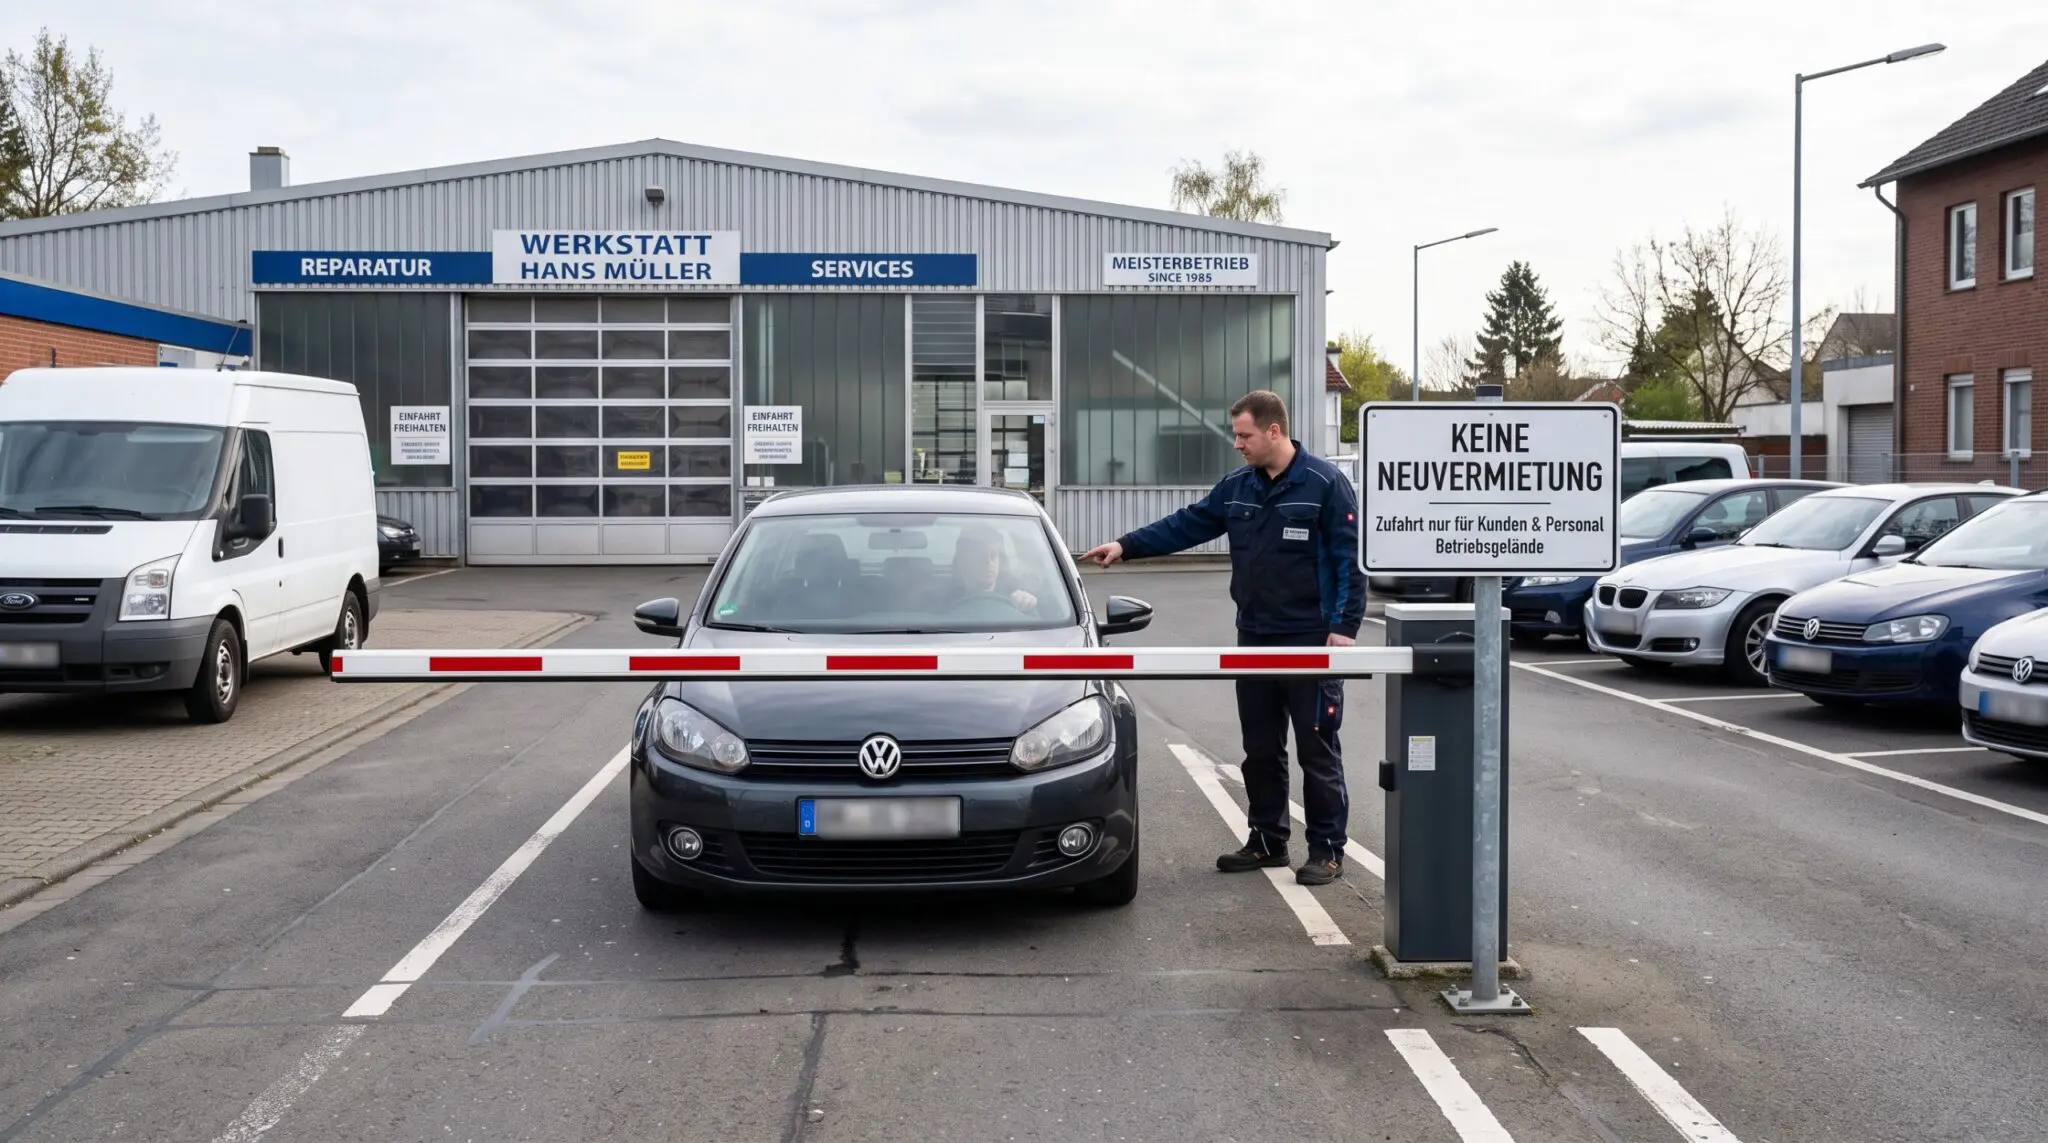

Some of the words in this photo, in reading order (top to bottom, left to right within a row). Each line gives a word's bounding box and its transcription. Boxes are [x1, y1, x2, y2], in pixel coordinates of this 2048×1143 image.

[520, 234, 712, 255] WERKSTATT
[300, 258, 432, 277] REPARATUR
[521, 262, 596, 280] HANS
[604, 258, 712, 280] MÜLLER
[811, 260, 914, 278] SERVICES
[1112, 257, 1249, 270] MEISTERBETRIEB
[1148, 273, 1182, 282] SINCE
[1186, 273, 1212, 282] 1985
[399, 412, 441, 421] EINFAHRT
[752, 412, 794, 421] EINFAHRT
[394, 424, 446, 432] FREIHALTEN
[747, 424, 799, 432] FREIHALTEN
[1451, 423, 1529, 453] KEINE
[1377, 462, 1603, 491] NEUVERMIETUNG
[1375, 516, 1424, 532] Zufahrt
[1428, 519, 1450, 532] nur
[1454, 516, 1474, 532] für
[1478, 516, 1528, 532] Kunden
[1531, 516, 1541, 532] &
[1546, 516, 1604, 532] Personal
[1436, 538, 1544, 558] Betriebsgelände
